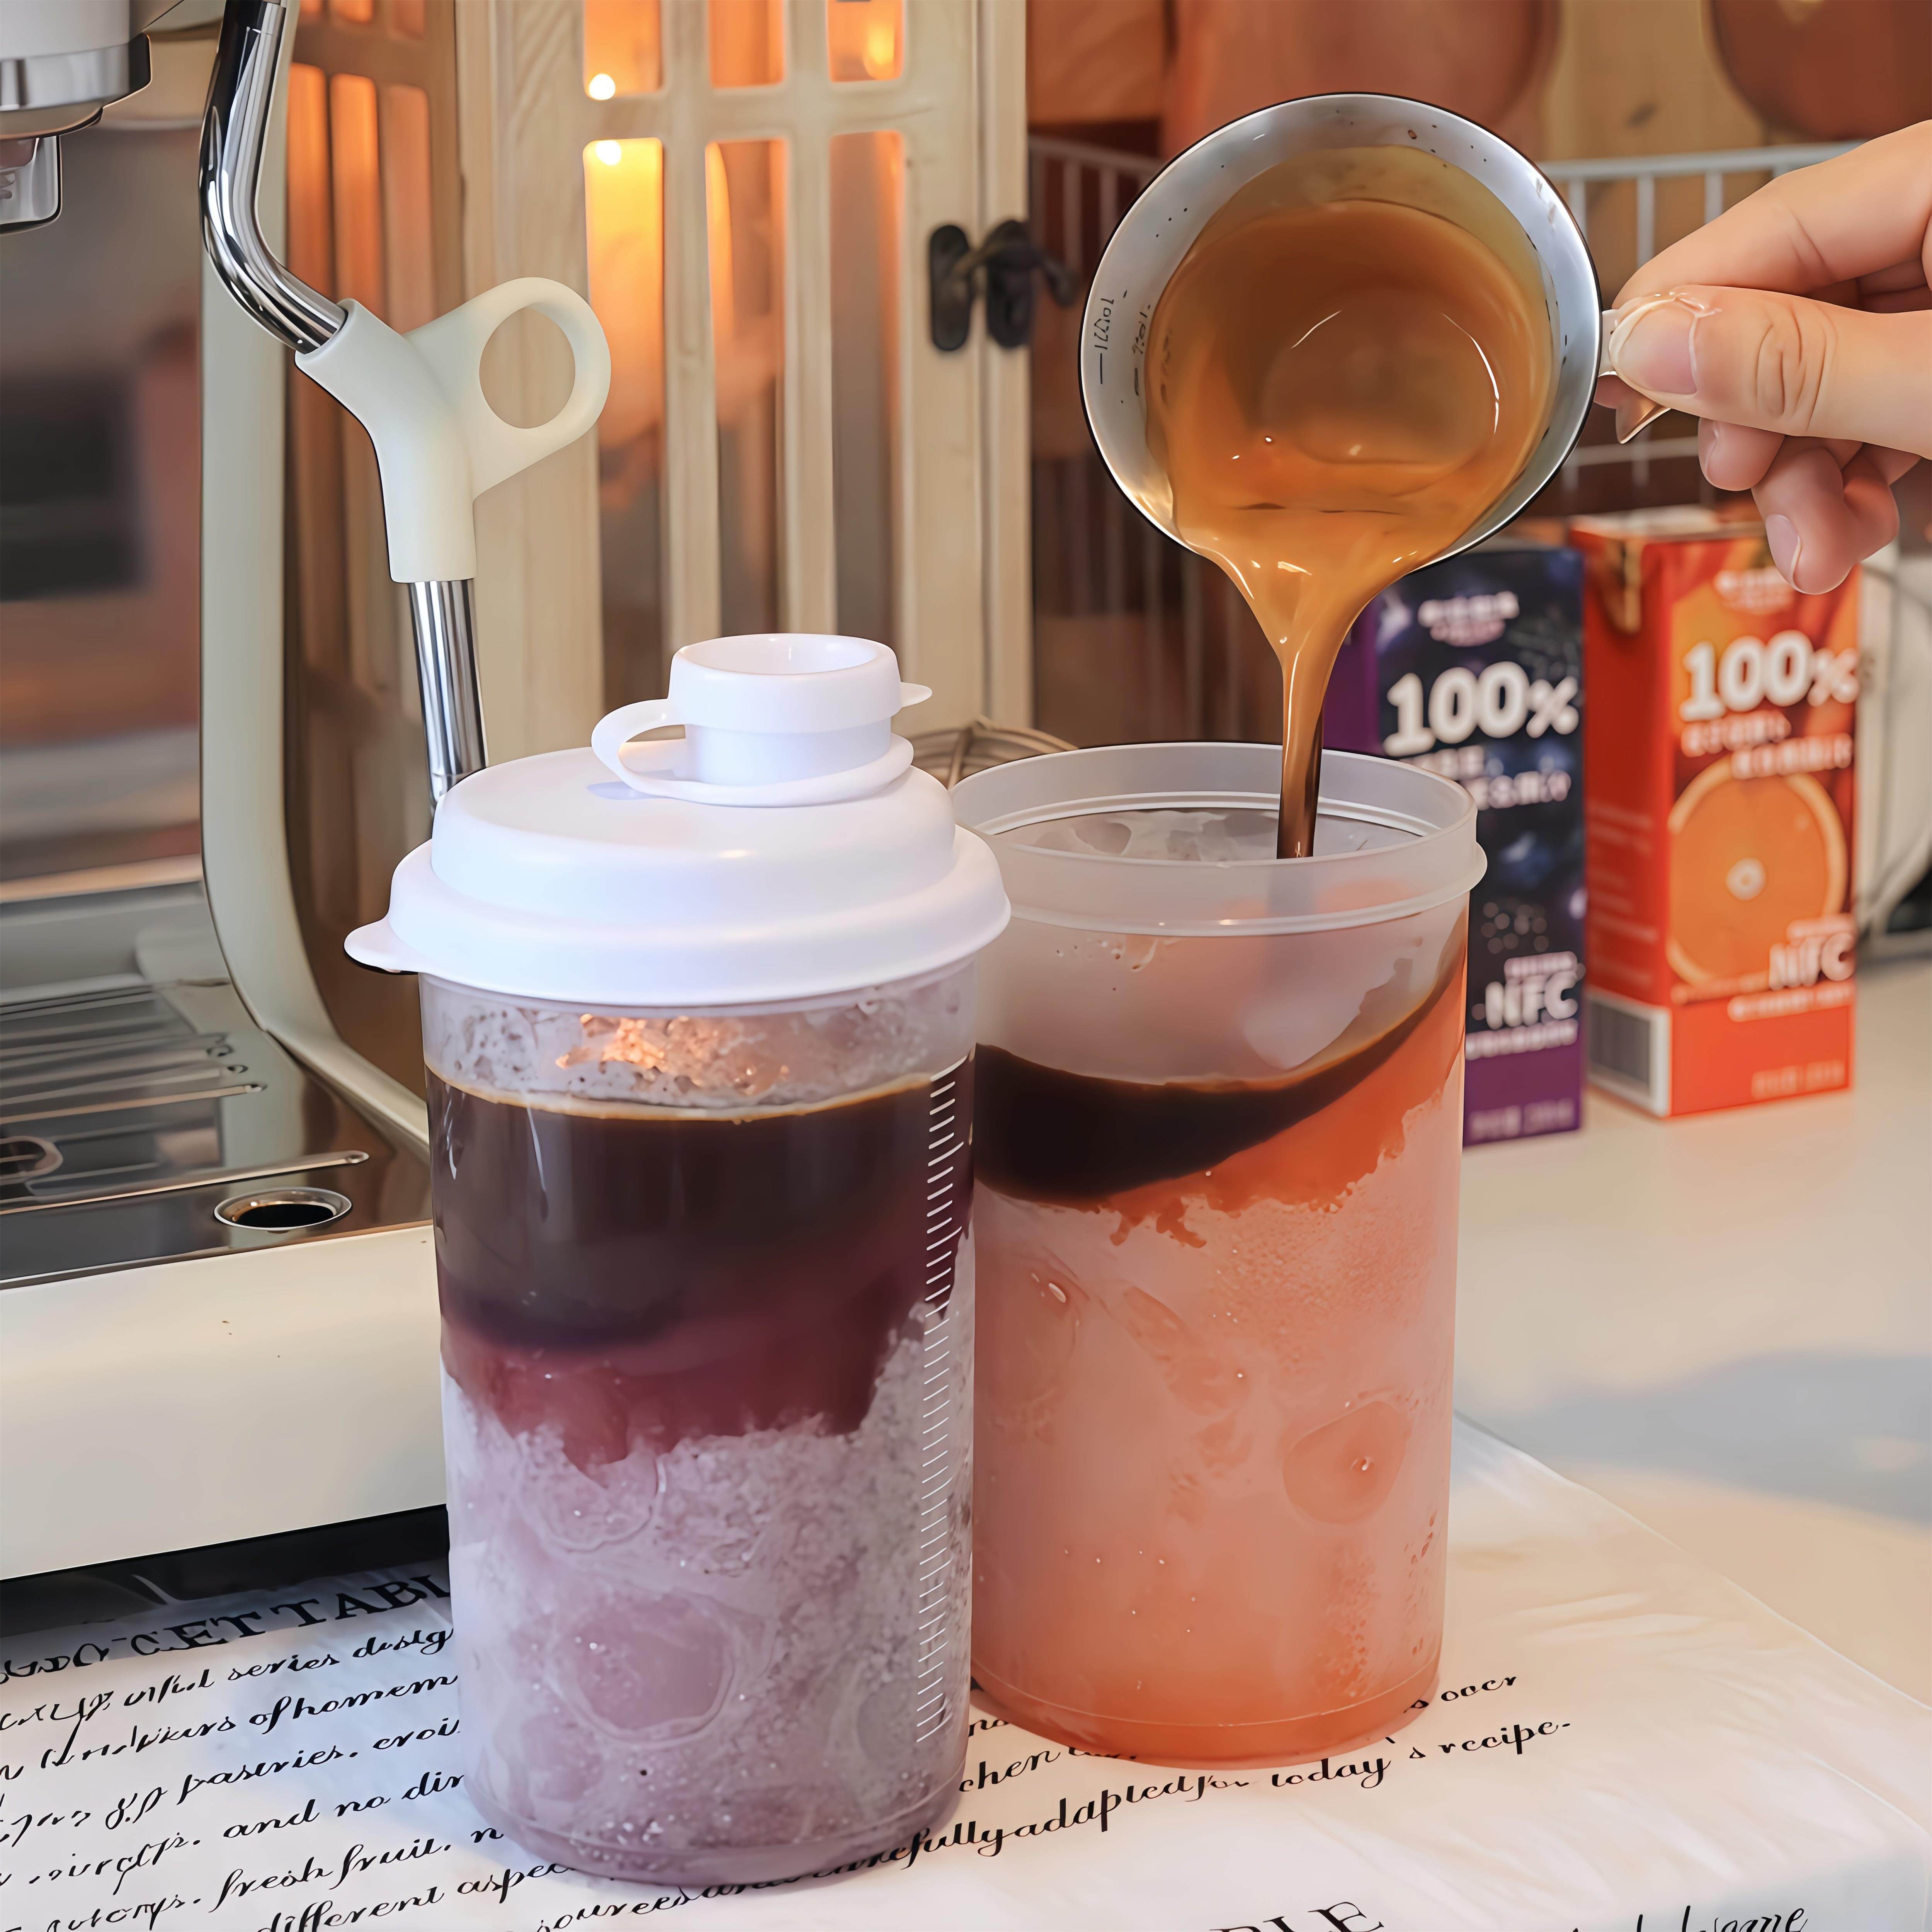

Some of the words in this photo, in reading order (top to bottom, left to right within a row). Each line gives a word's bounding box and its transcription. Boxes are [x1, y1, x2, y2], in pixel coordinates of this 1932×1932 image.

[1384, 661, 1579, 756] 100%
[1679, 630, 1859, 722] 100%
[228, 1655, 340, 1680] series
[223, 1799, 319, 1838] and
